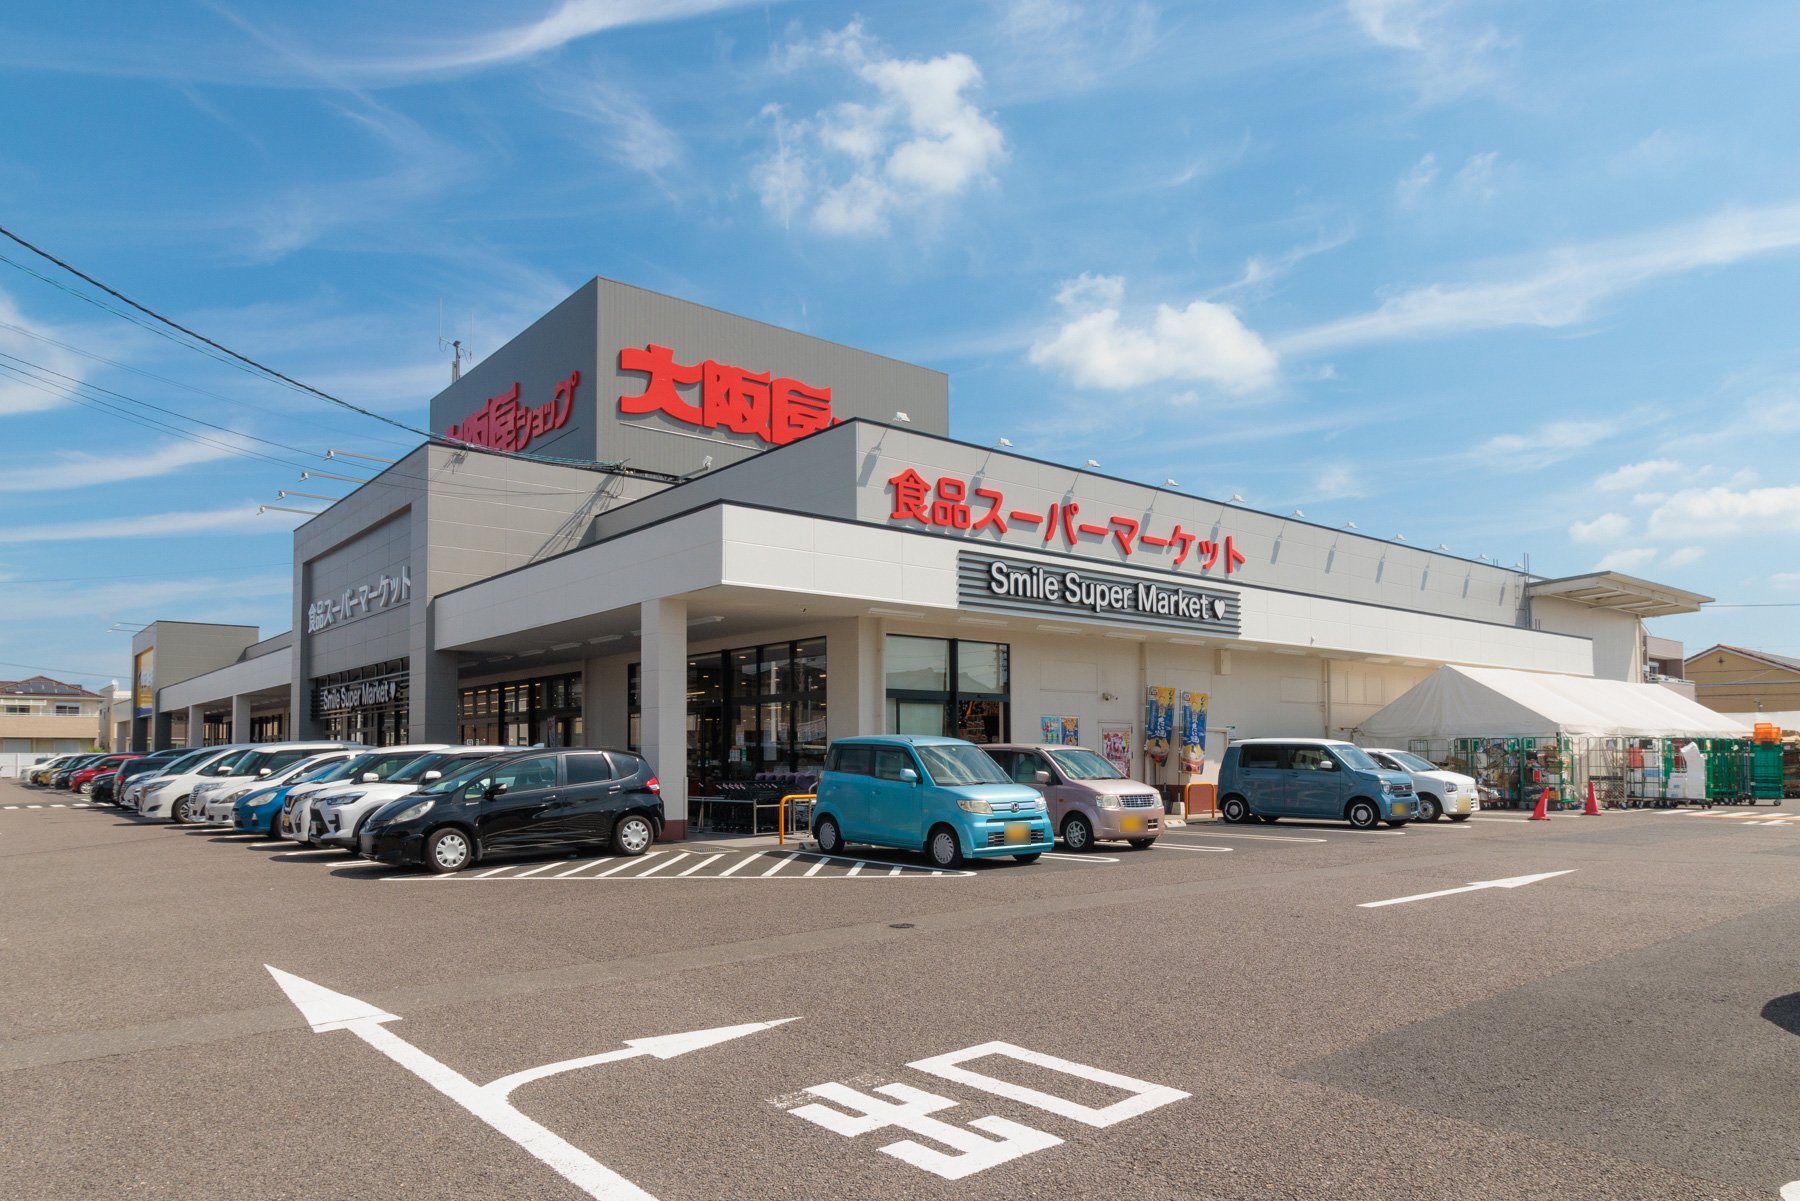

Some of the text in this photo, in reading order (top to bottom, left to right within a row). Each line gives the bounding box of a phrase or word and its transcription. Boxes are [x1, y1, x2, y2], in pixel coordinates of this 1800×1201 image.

[620, 343, 842, 445] 大阪屋
[888, 468, 1246, 574] 食品スーパーマーケット
[307, 565, 411, 633] 食品スーパーマーケット
[990, 561, 1209, 620] Smile Super Market
[323, 680, 389, 712] Smile Super Market
[787, 1041, 1193, 1180] 出口
